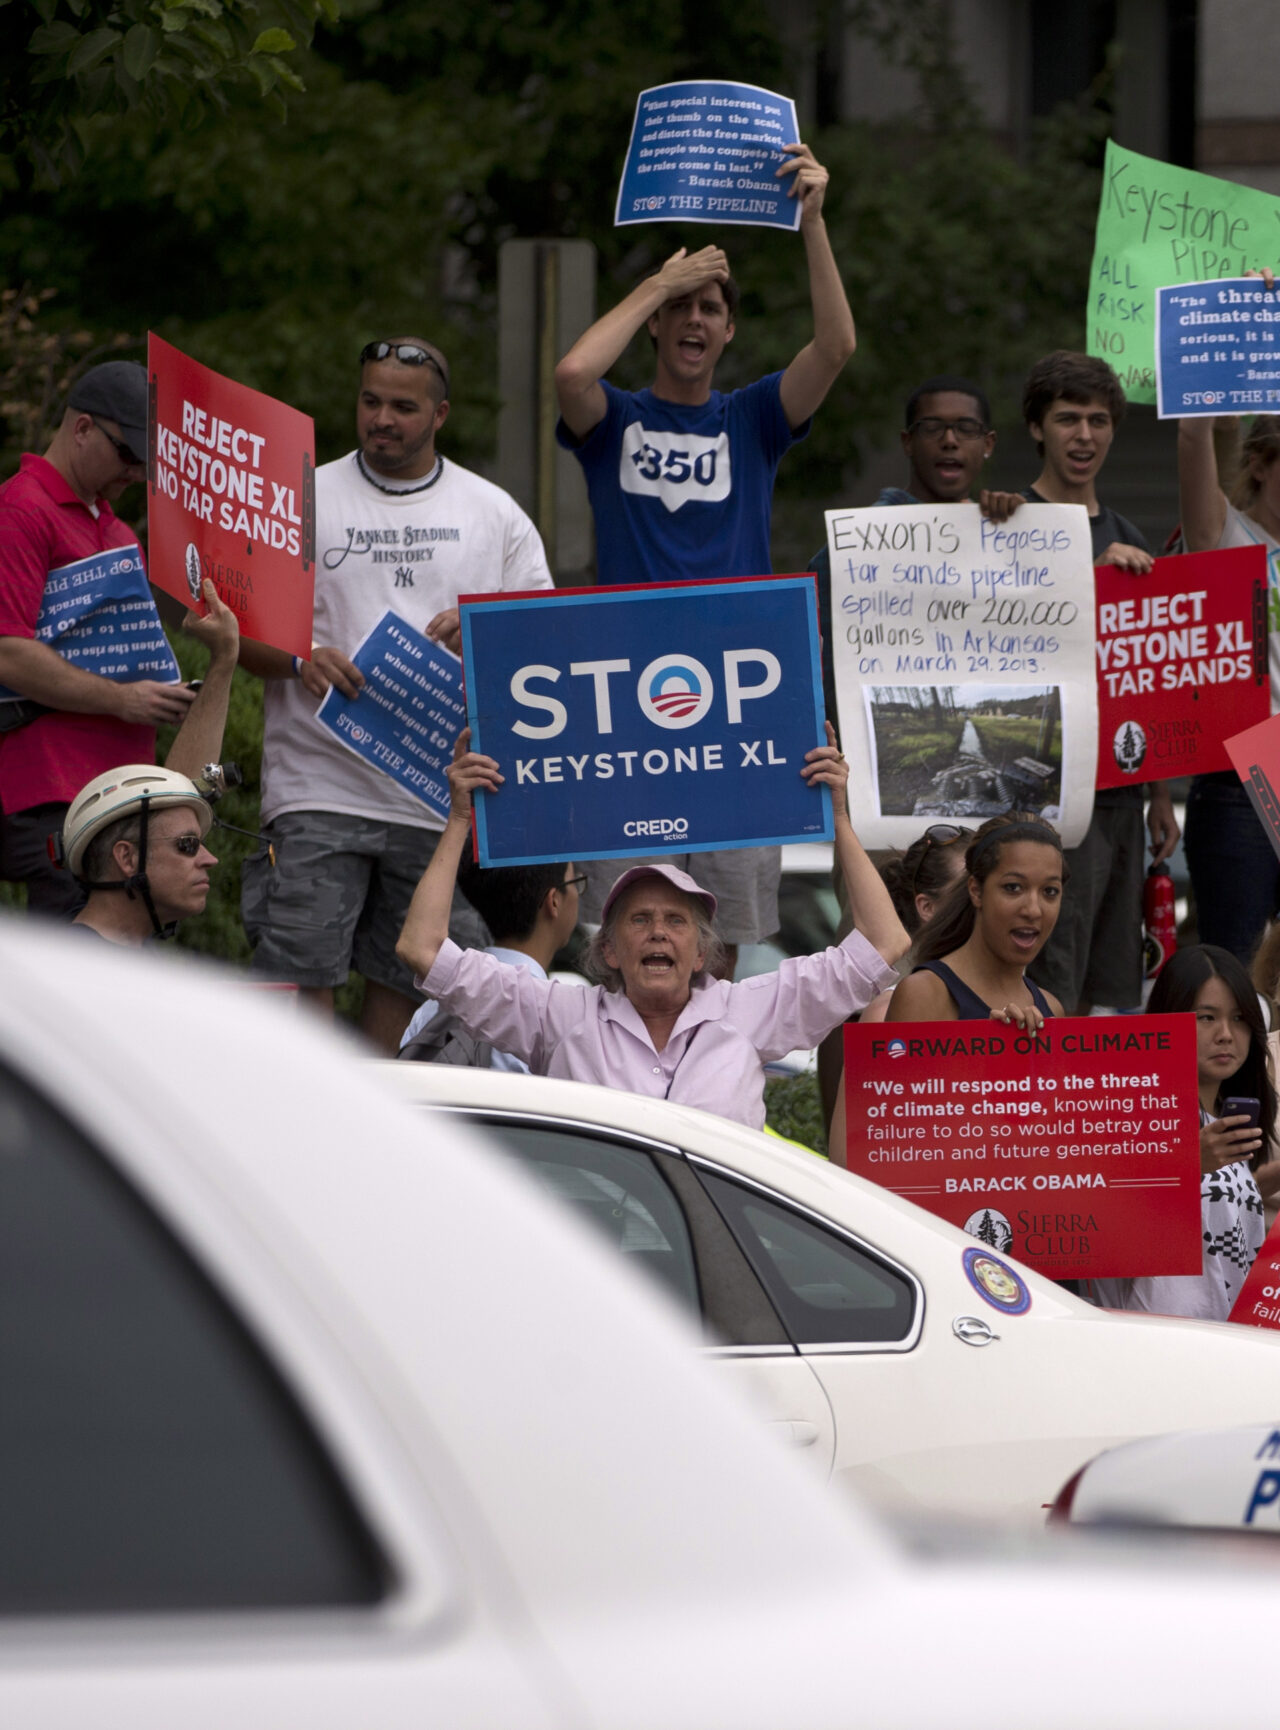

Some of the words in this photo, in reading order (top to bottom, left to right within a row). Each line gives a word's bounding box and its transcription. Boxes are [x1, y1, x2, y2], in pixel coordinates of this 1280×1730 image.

[711, 97, 761, 111] interests
[633, 197, 665, 211] STOP
[669, 196, 702, 209] THE
[707, 198, 777, 214] PIPELINE
[1107, 155, 1249, 250] Keystone
[1100, 257, 1138, 289] ALL
[1098, 293, 1144, 324] RISK
[1180, 312, 1250, 325] climate
[1096, 329, 1125, 354] NO
[1180, 334, 1240, 345] serious,
[1245, 331, 1257, 341] it
[1262, 332, 1274, 341] is
[1183, 392, 1225, 405] STOP
[1230, 391, 1261, 403] THE
[182, 400, 265, 468] REJECT
[157, 424, 264, 510] KEYSTONE
[271, 482, 301, 525] XL
[157, 463, 178, 500] NO
[182, 481, 214, 523] TAR
[219, 502, 300, 556] SANDS
[832, 516, 959, 553] Exxon's
[980, 517, 1070, 566] Pegasus
[372, 547, 435, 563] HISTORY
[845, 558, 878, 583] tar
[893, 561, 961, 585] sands
[971, 561, 1054, 599] pipeline
[842, 592, 913, 624] spilled
[927, 599, 971, 623] over
[1100, 590, 1207, 634] REJECT
[936, 631, 952, 652] in
[964, 631, 1059, 654] Arkansas
[1215, 620, 1252, 654] XL
[1105, 669, 1155, 697] TAR
[1161, 655, 1252, 690] SANDS
[509, 648, 782, 739] STOP
[335, 713, 373, 745] STOP
[374, 741, 404, 771] THE
[516, 744, 723, 784] KEYSTONE
[739, 740, 787, 767] XL
[623, 818, 688, 837] CREDO
[663, 833, 688, 841] action
[872, 1038, 1005, 1058] FORWARD
[1013, 1036, 1050, 1054] ON
[1062, 1031, 1171, 1053] CLIMATE
[863, 1082, 904, 1096] “We
[911, 1078, 945, 1093] will
[951, 1078, 1031, 1096] respond
[1037, 1077, 1057, 1091] to
[1063, 1075, 1095, 1089] the
[1101, 1073, 1160, 1088] threat
[867, 1102, 886, 1118] of
[893, 1102, 965, 1117] climate
[972, 1100, 1048, 1116] change,
[1054, 1098, 1134, 1115] knowing
[1140, 1094, 1177, 1109] that
[867, 1124, 926, 1140] failure
[932, 1124, 952, 1139] to
[958, 1122, 983, 1138] do
[990, 1124, 1012, 1137] so
[1018, 1120, 1075, 1137] would
[1081, 1119, 1142, 1137] betray
[1149, 1119, 1180, 1131] our
[868, 1147, 944, 1163] children
[951, 1145, 986, 1160] and
[993, 1144, 1050, 1159] future
[1056, 1138, 1181, 1159] generations.”
[945, 1176, 1027, 1194] BARACK
[1032, 1173, 1106, 1190] OBAMA
